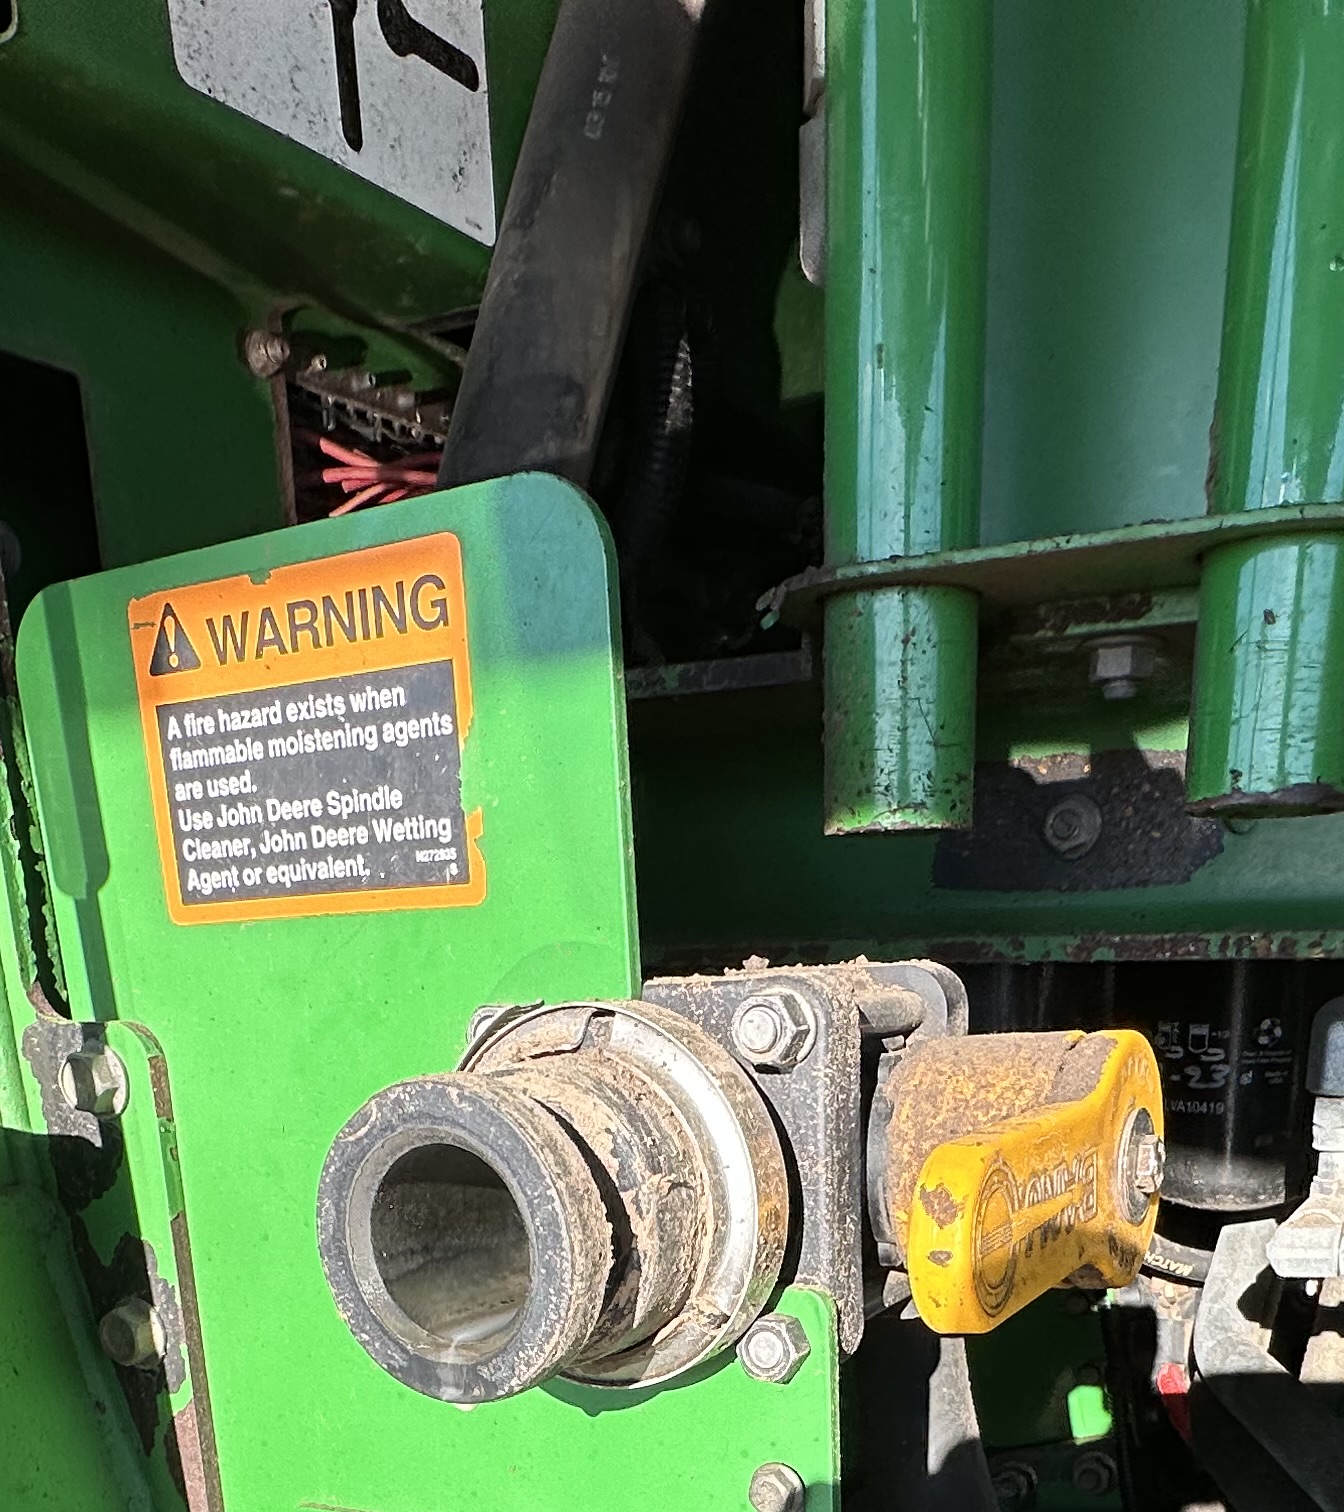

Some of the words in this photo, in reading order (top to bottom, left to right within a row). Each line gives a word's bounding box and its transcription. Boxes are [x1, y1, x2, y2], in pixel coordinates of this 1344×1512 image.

[205, 574, 449, 666] WARNING
[168, 716, 183, 740] A
[184, 711, 215, 737] fire
[219, 701, 282, 733] hazard
[286, 695, 345, 723] exists
[349, 686, 406, 712] when
[169, 738, 264, 771] flammable
[268, 723, 378, 759] moistening
[382, 712, 453, 746] agents
[175, 781, 203, 801] are
[206, 770, 257, 797] used.
[178, 808, 213, 832] Use
[217, 801, 262, 827] John
[267, 797, 322, 822] Deere
[326, 784, 403, 819] Spindle
[183, 836, 256, 861] Cleaner,
[260, 827, 307, 853] John
[311, 824, 369, 850] Deere
[371, 817, 452, 844] Wetting
[187, 866, 238, 895] Agent
[243, 867, 262, 886] or
[266, 854, 370, 887] equivalent.
